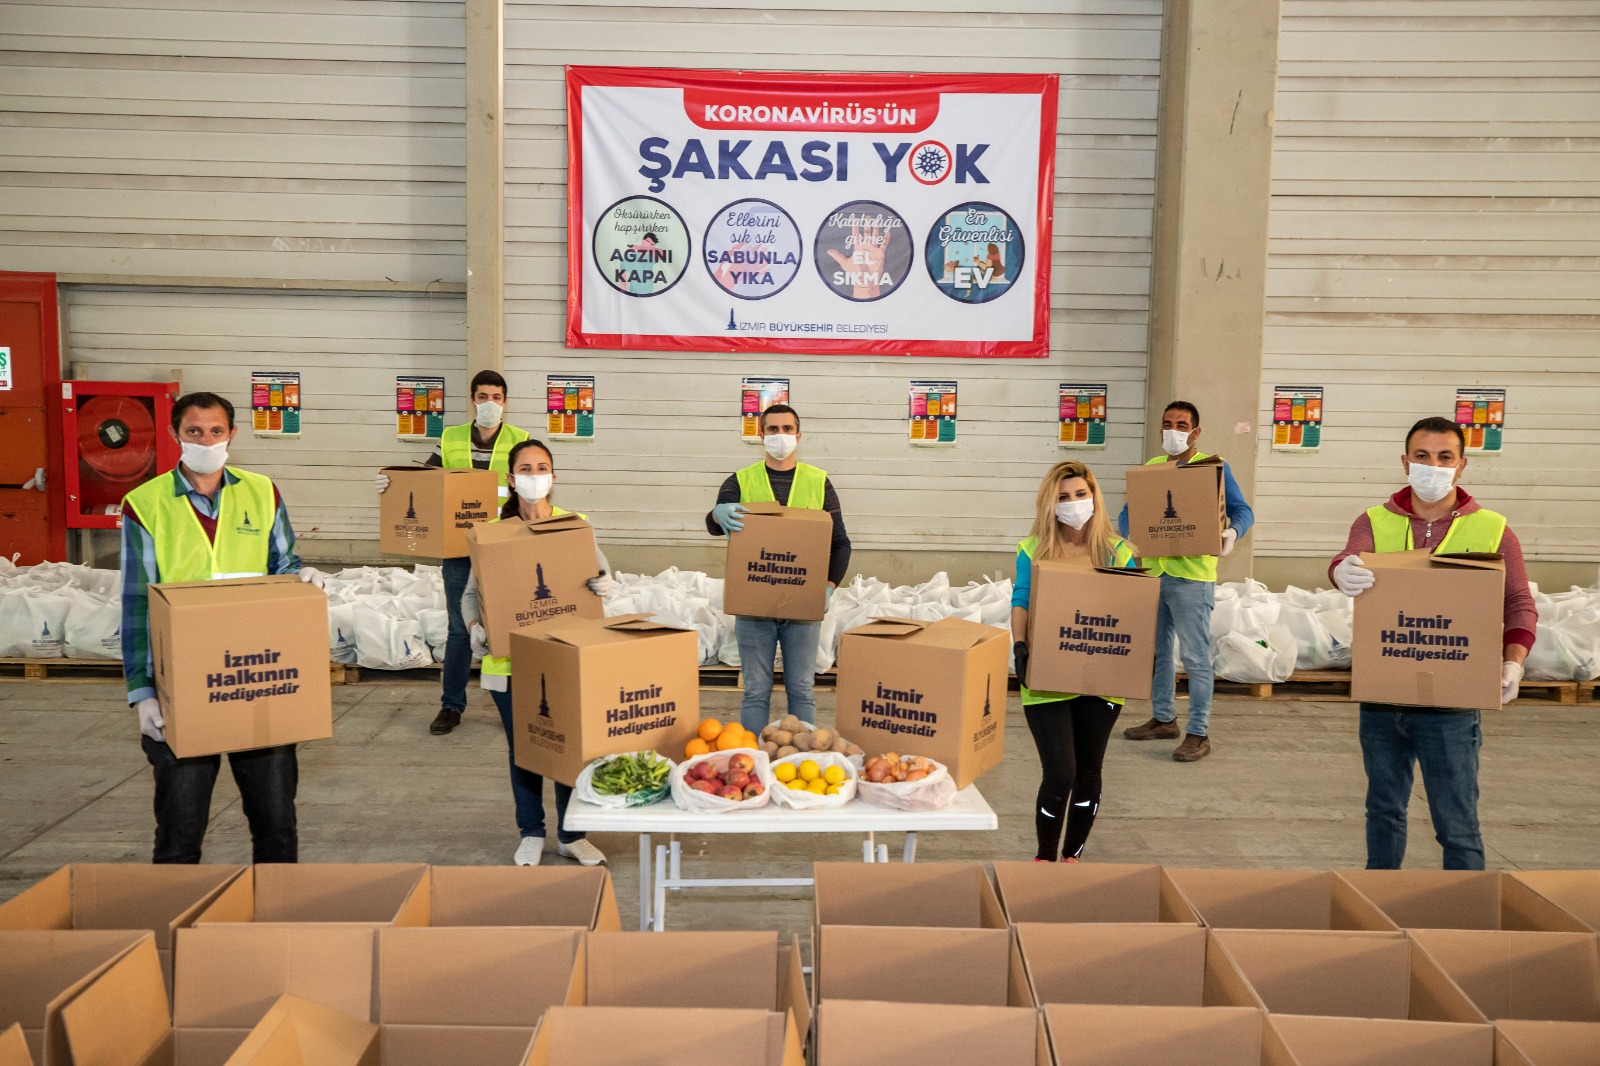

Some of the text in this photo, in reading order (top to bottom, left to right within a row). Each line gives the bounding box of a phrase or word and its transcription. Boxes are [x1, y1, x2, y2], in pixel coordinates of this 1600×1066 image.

[704, 101, 916, 125] KORONAVİRÜS'ÜN
[638, 137, 848, 193] ŞAKASI
[613, 208, 671, 220] Öksürürken
[726, 211, 781, 227] Ellerini
[828, 213, 903, 232] Kalabalığa
[965, 208, 988, 226] En
[614, 220, 669, 235] hapşırırken
[938, 225, 1014, 248] Güvenlisi
[730, 230, 777, 244] sık sık
[845, 234, 884, 250] girme
[610, 244, 673, 263] AĞZINI
[707, 250, 797, 265] SABUNLA
[852, 250, 875, 265] EL
[615, 269, 668, 284] KAPA
[730, 271, 775, 285] YIKA
[833, 271, 894, 286] SIKMA
[954, 267, 995, 289] EV
[739, 322, 888, 334] İZMİR BÜYÜKŞEHİR BELEDİYESİ
[461, 499, 482, 509] İzmir
[760, 547, 797, 562] İzmir
[748, 561, 807, 576] Halkının
[747, 574, 806, 586] Hediyesidir
[1074, 609, 1119, 628] İzmir
[1398, 610, 1452, 629] İzmir
[1059, 626, 1132, 644] Halkının
[1381, 630, 1469, 647] Halkının
[1059, 641, 1131, 656] Hediyesidir
[1382, 647, 1469, 661] Hediyesidir
[224, 649, 281, 668] İzmir
[207, 667, 298, 688] Halkının
[209, 683, 299, 703] Hediyesidir
[619, 684, 663, 704] İzmir
[876, 682, 924, 704] İzmir
[606, 701, 676, 723] Halkının
[861, 700, 937, 724] Halkının
[608, 715, 676, 738] Hediyesidir
[861, 717, 937, 738] Hediyesidir
